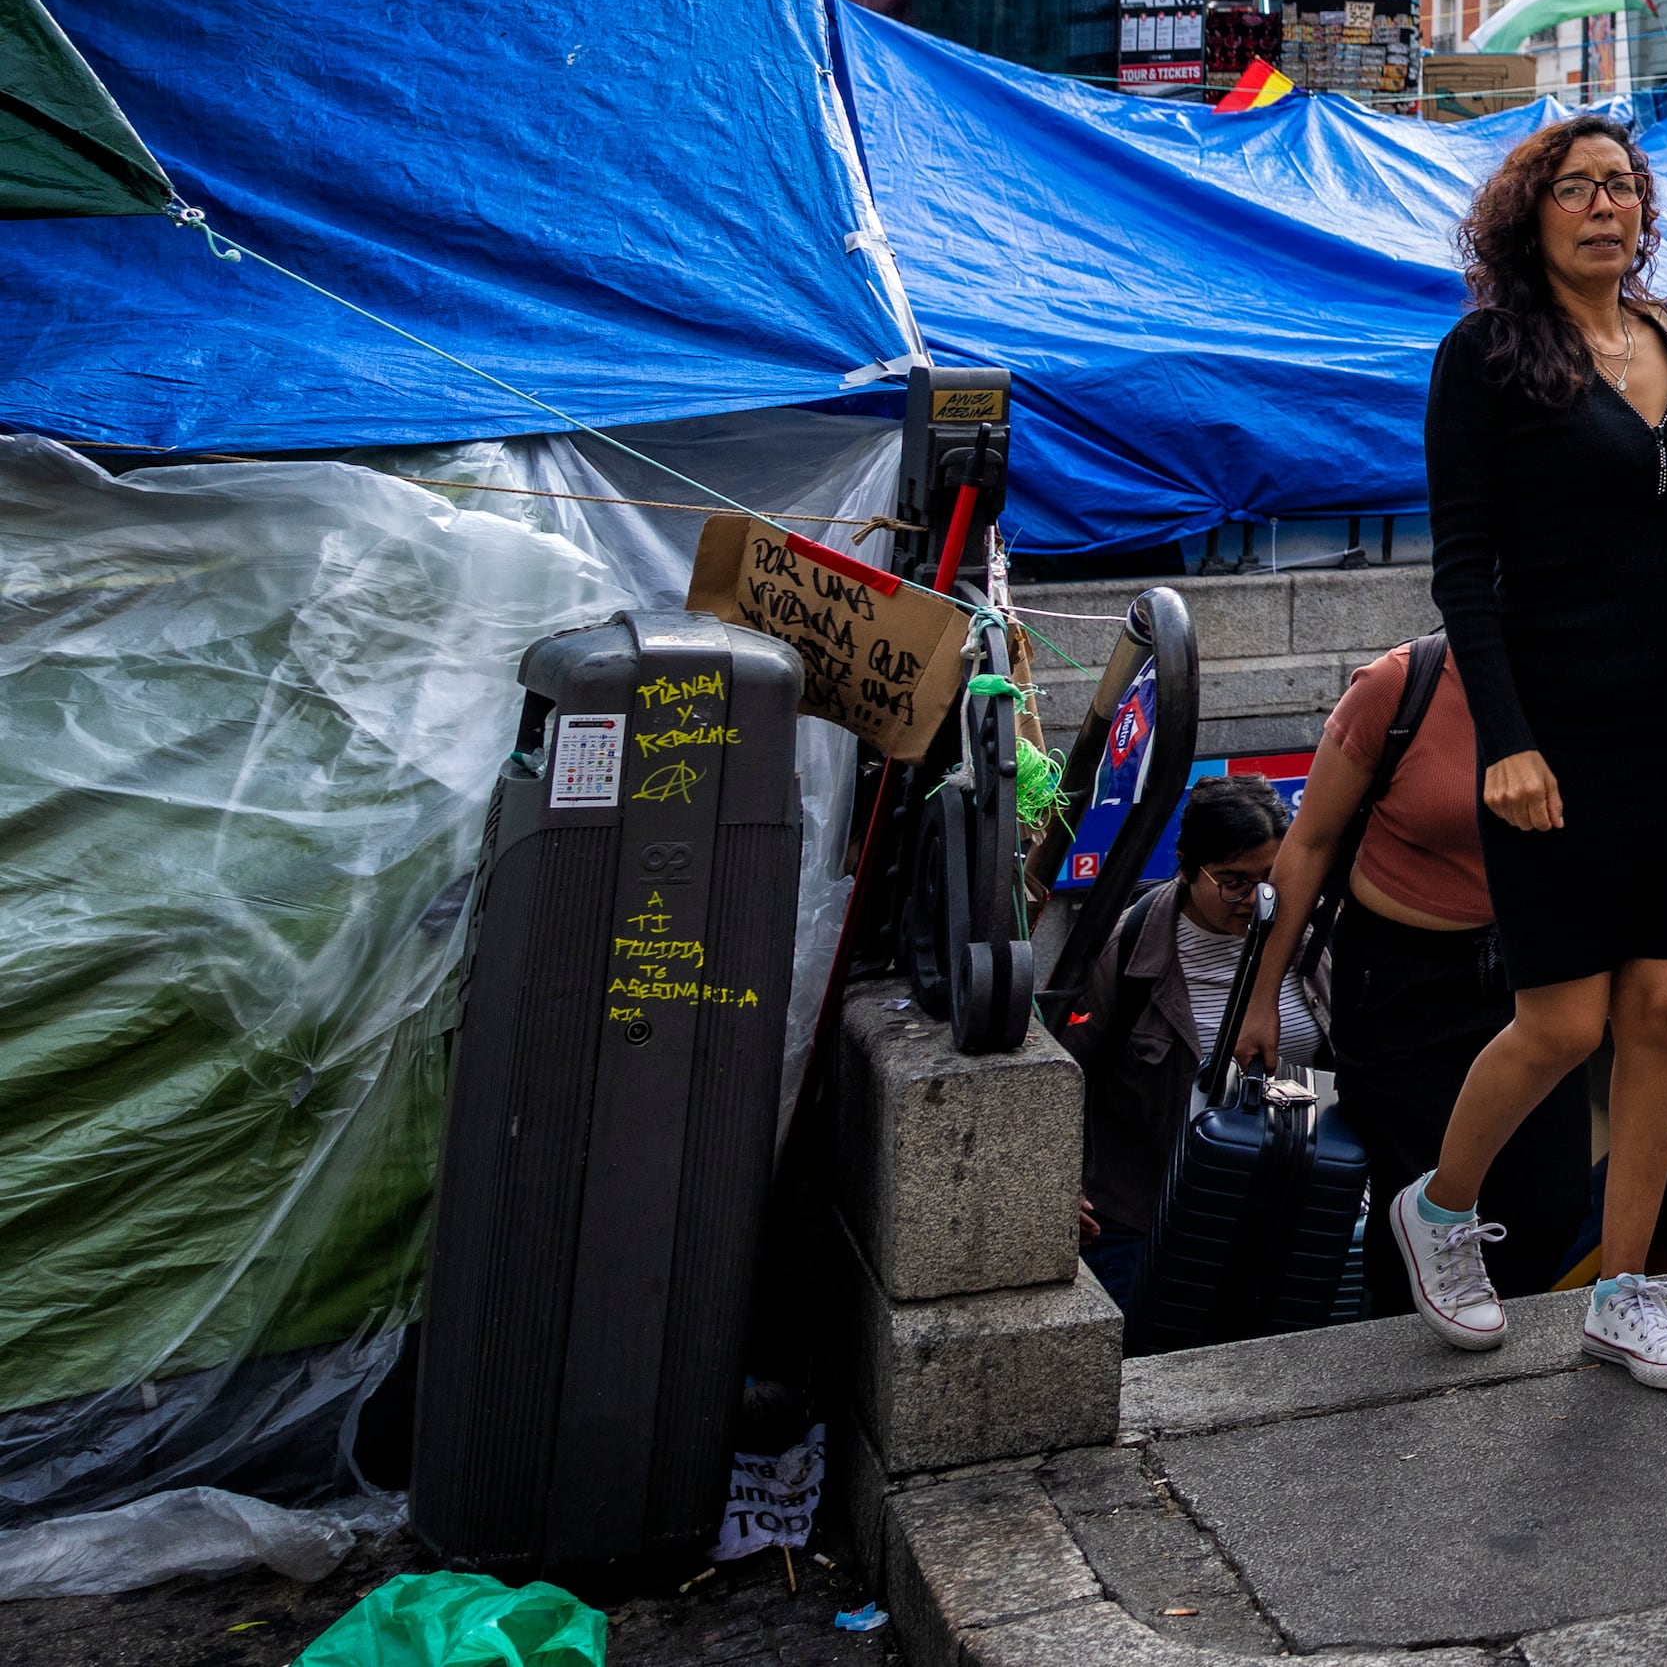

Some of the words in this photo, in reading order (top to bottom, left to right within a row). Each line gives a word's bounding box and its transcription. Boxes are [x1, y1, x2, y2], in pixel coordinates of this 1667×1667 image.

[1122, 68, 1147, 81] TOUR
[1148, 69, 1156, 80] &
[1157, 65, 1200, 80] TICKETS
[945, 392, 993, 405] AYUSO
[935, 404, 996, 419] ASESINA
[752, 537, 804, 587] POR
[812, 567, 875, 621] UNA
[868, 638, 921, 685] QUE
[676, 704, 694, 727] Y
[1116, 712, 1134, 748] Metro
[1078, 857, 1094, 877] 2
[647, 891, 664, 908] A
[626, 914, 673, 932] TI
